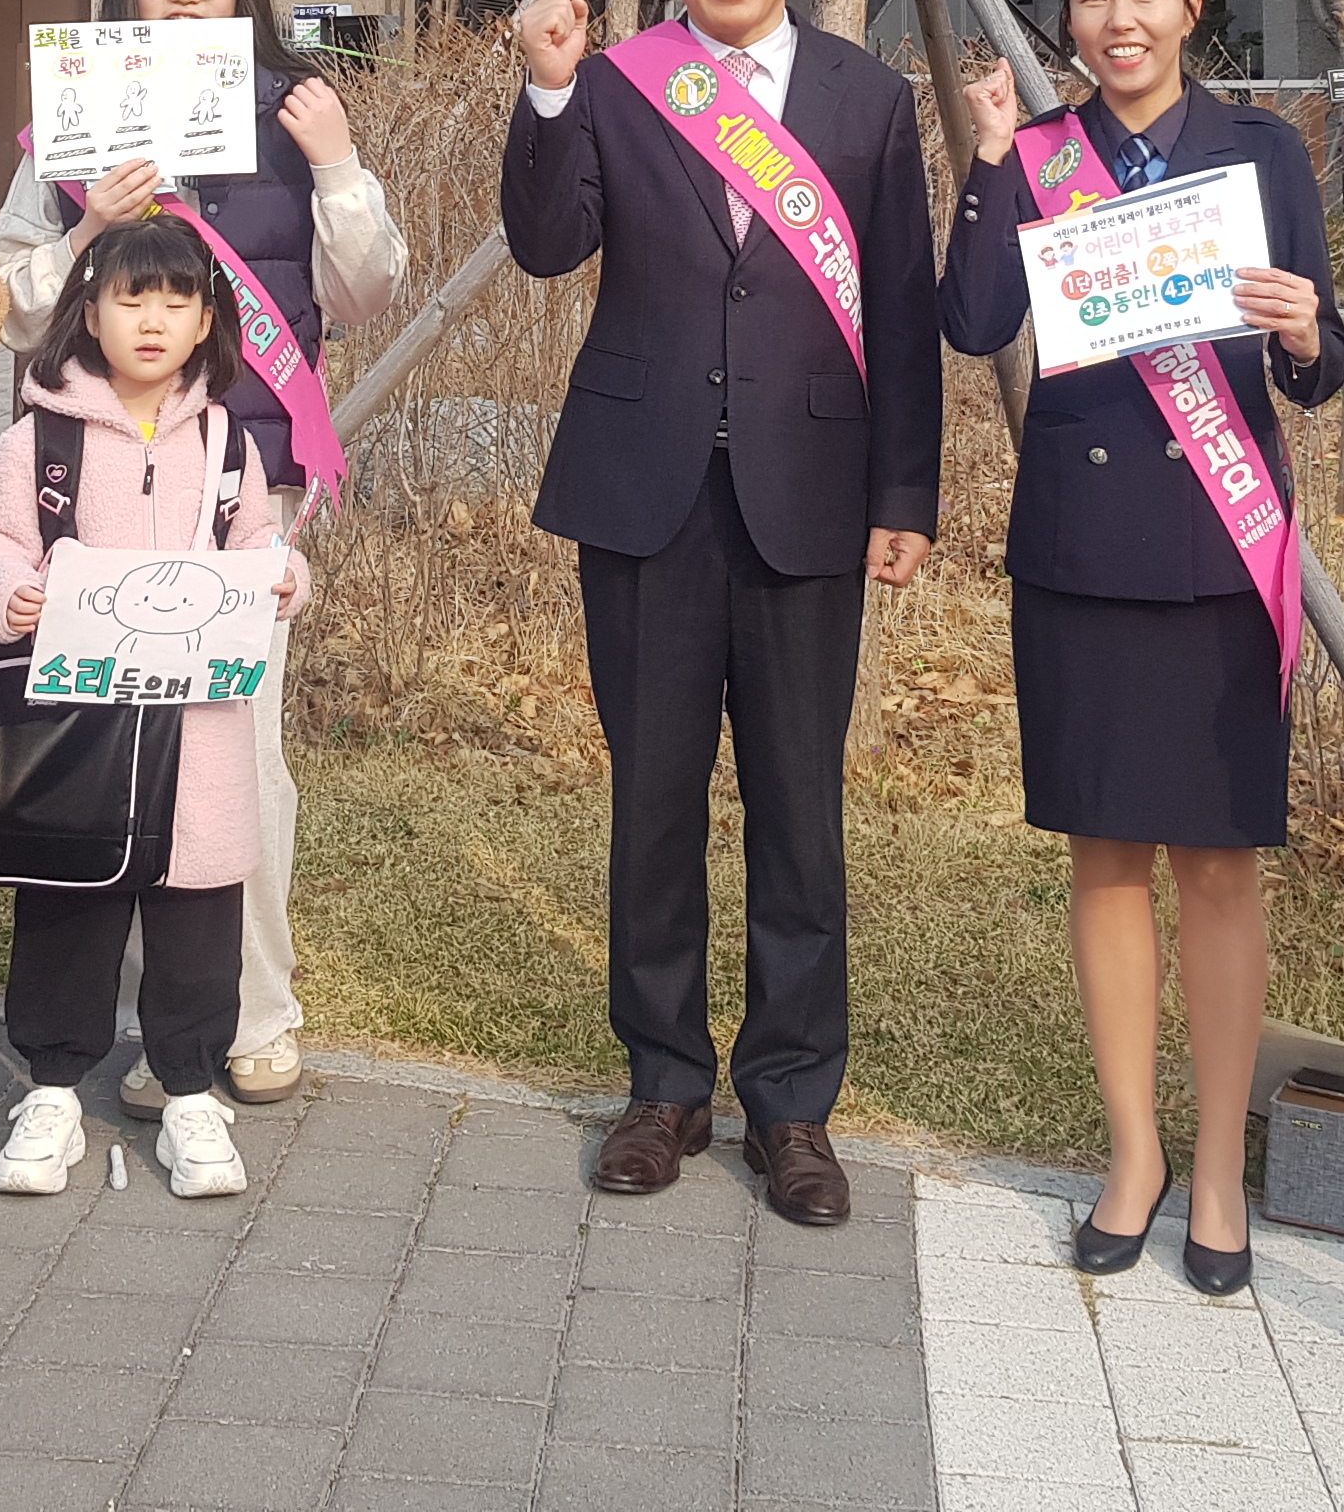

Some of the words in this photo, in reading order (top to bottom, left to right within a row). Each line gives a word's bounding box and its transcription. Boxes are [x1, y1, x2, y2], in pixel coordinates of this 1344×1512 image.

[34, 27, 83, 50] 초록불을
[95, 28, 123, 45] 건널
[133, 26, 151, 43] 땐
[196, 53, 228, 65] 건너기
[59, 56, 86, 77] 확인
[715, 114, 795, 191] 스쿨존
[787, 191, 812, 218] 30
[1053, 225, 1079, 239] 어린이
[1081, 217, 1116, 234] 교통안전
[1117, 208, 1144, 224] 릴레이
[1174, 193, 1201, 210] 캠페인
[1085, 228, 1140, 259] 어린이
[1147, 205, 1224, 243] 보호구역
[1148, 342, 1261, 506] 행해주세요
[208, 657, 268, 699] 걷기
